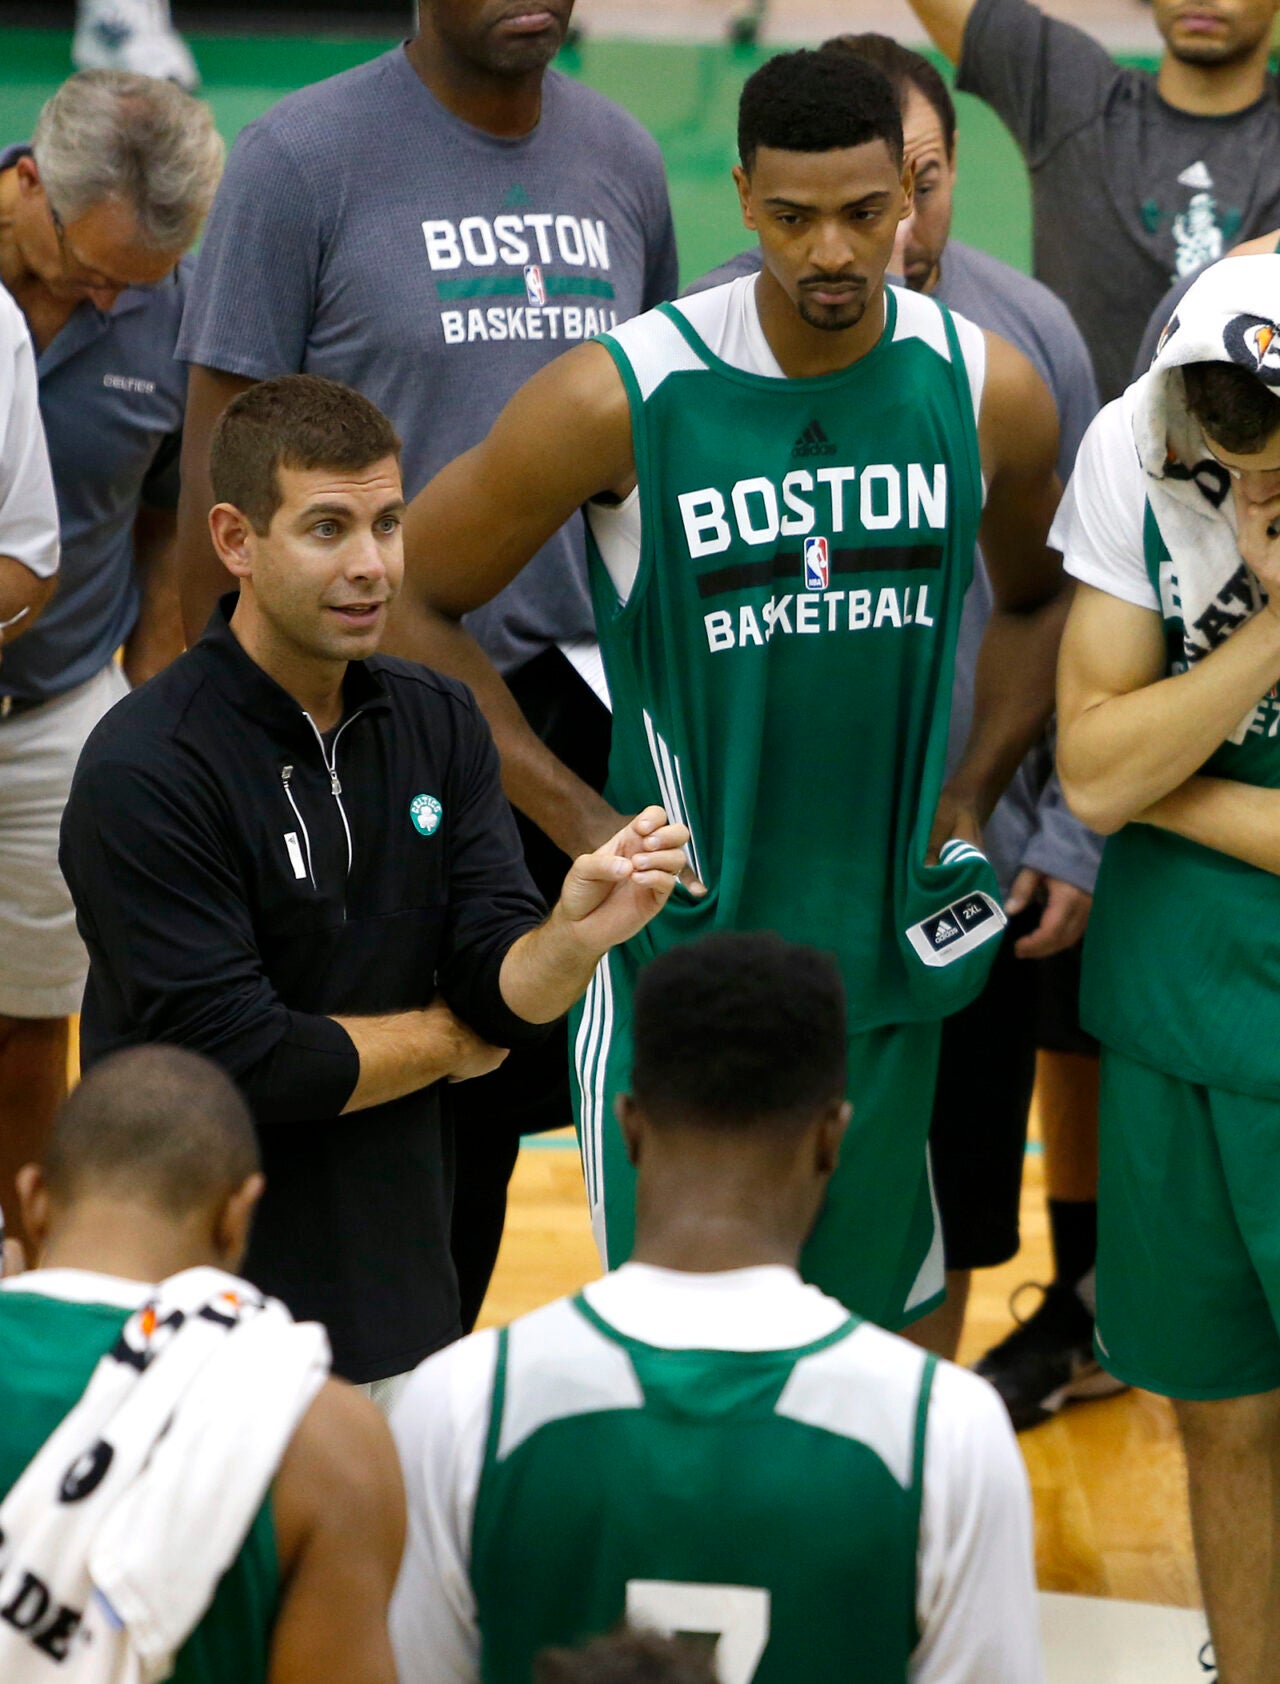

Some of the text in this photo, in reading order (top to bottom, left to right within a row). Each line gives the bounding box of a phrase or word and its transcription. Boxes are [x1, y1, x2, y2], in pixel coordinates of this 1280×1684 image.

[422, 213, 610, 271] BOSTON
[677, 463, 947, 559] BOSTON
[703, 585, 934, 653] BASKETBALL
[934, 926, 959, 944] adidas
[962, 904, 982, 920] 2XL
